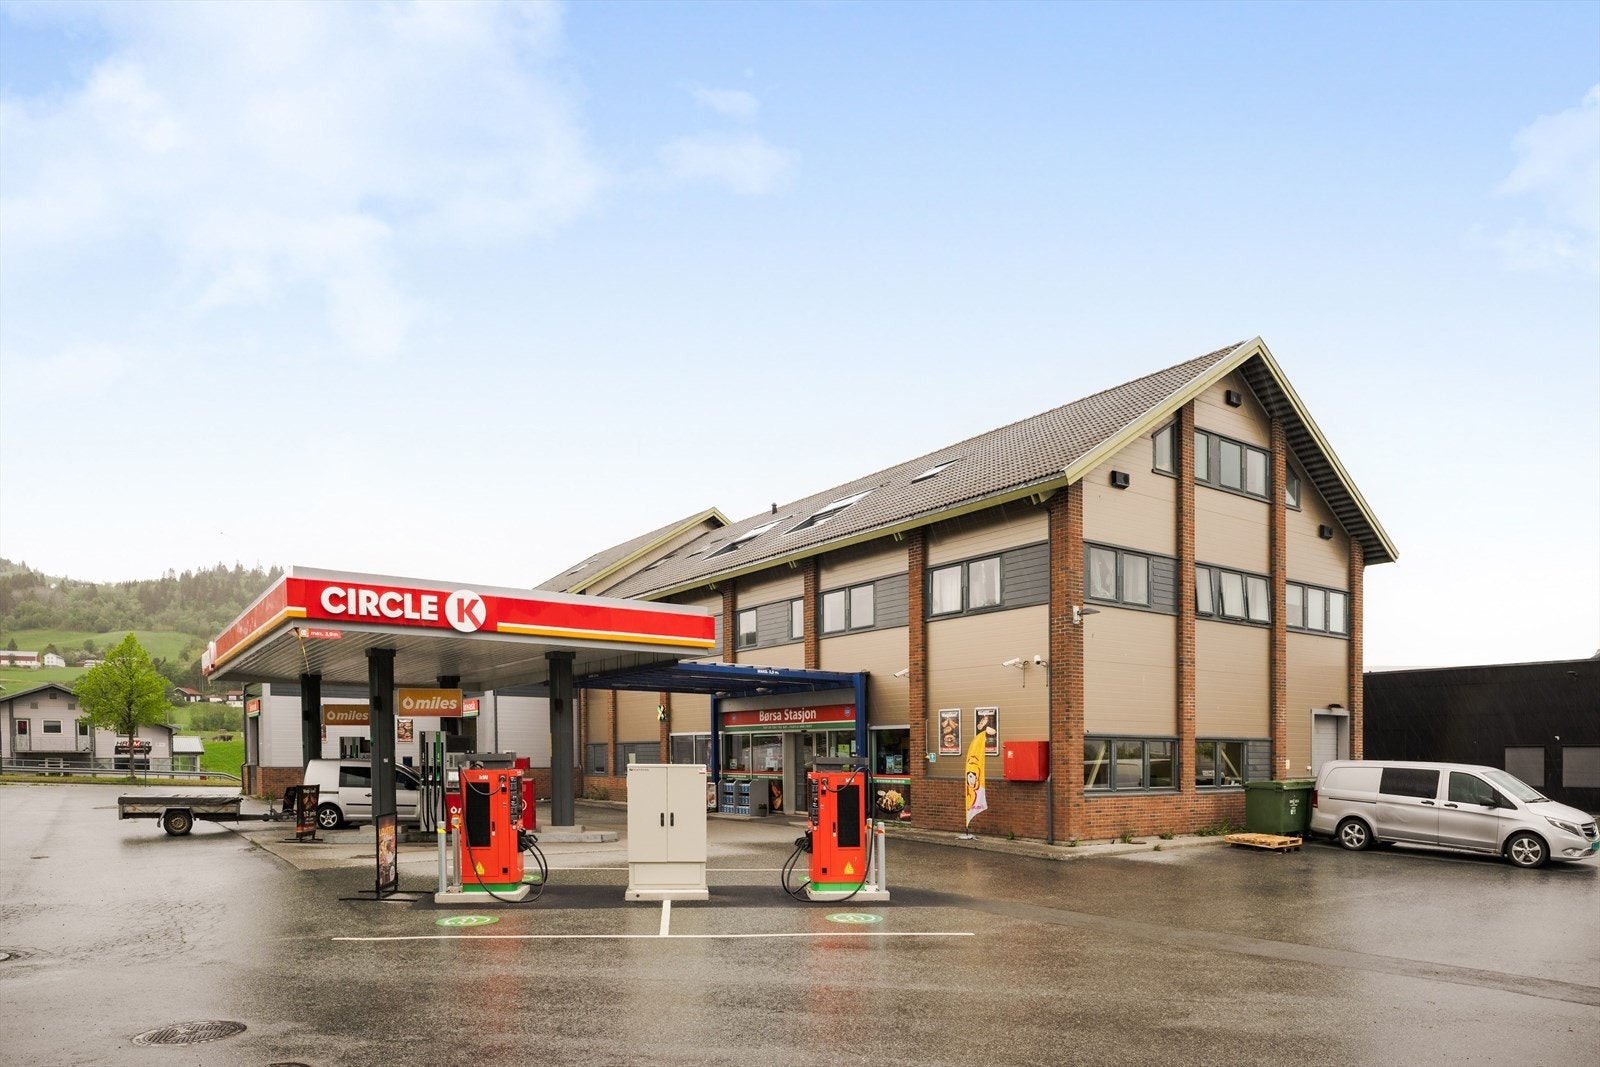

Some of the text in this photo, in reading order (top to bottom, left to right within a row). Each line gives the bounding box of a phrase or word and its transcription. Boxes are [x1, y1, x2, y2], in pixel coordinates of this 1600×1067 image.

[320, 586, 485, 630] CIRCLE K
[415, 696, 458, 710] miles
[336, 710, 369, 720] miles
[759, 707, 817, 723] Børsa Stasjon
